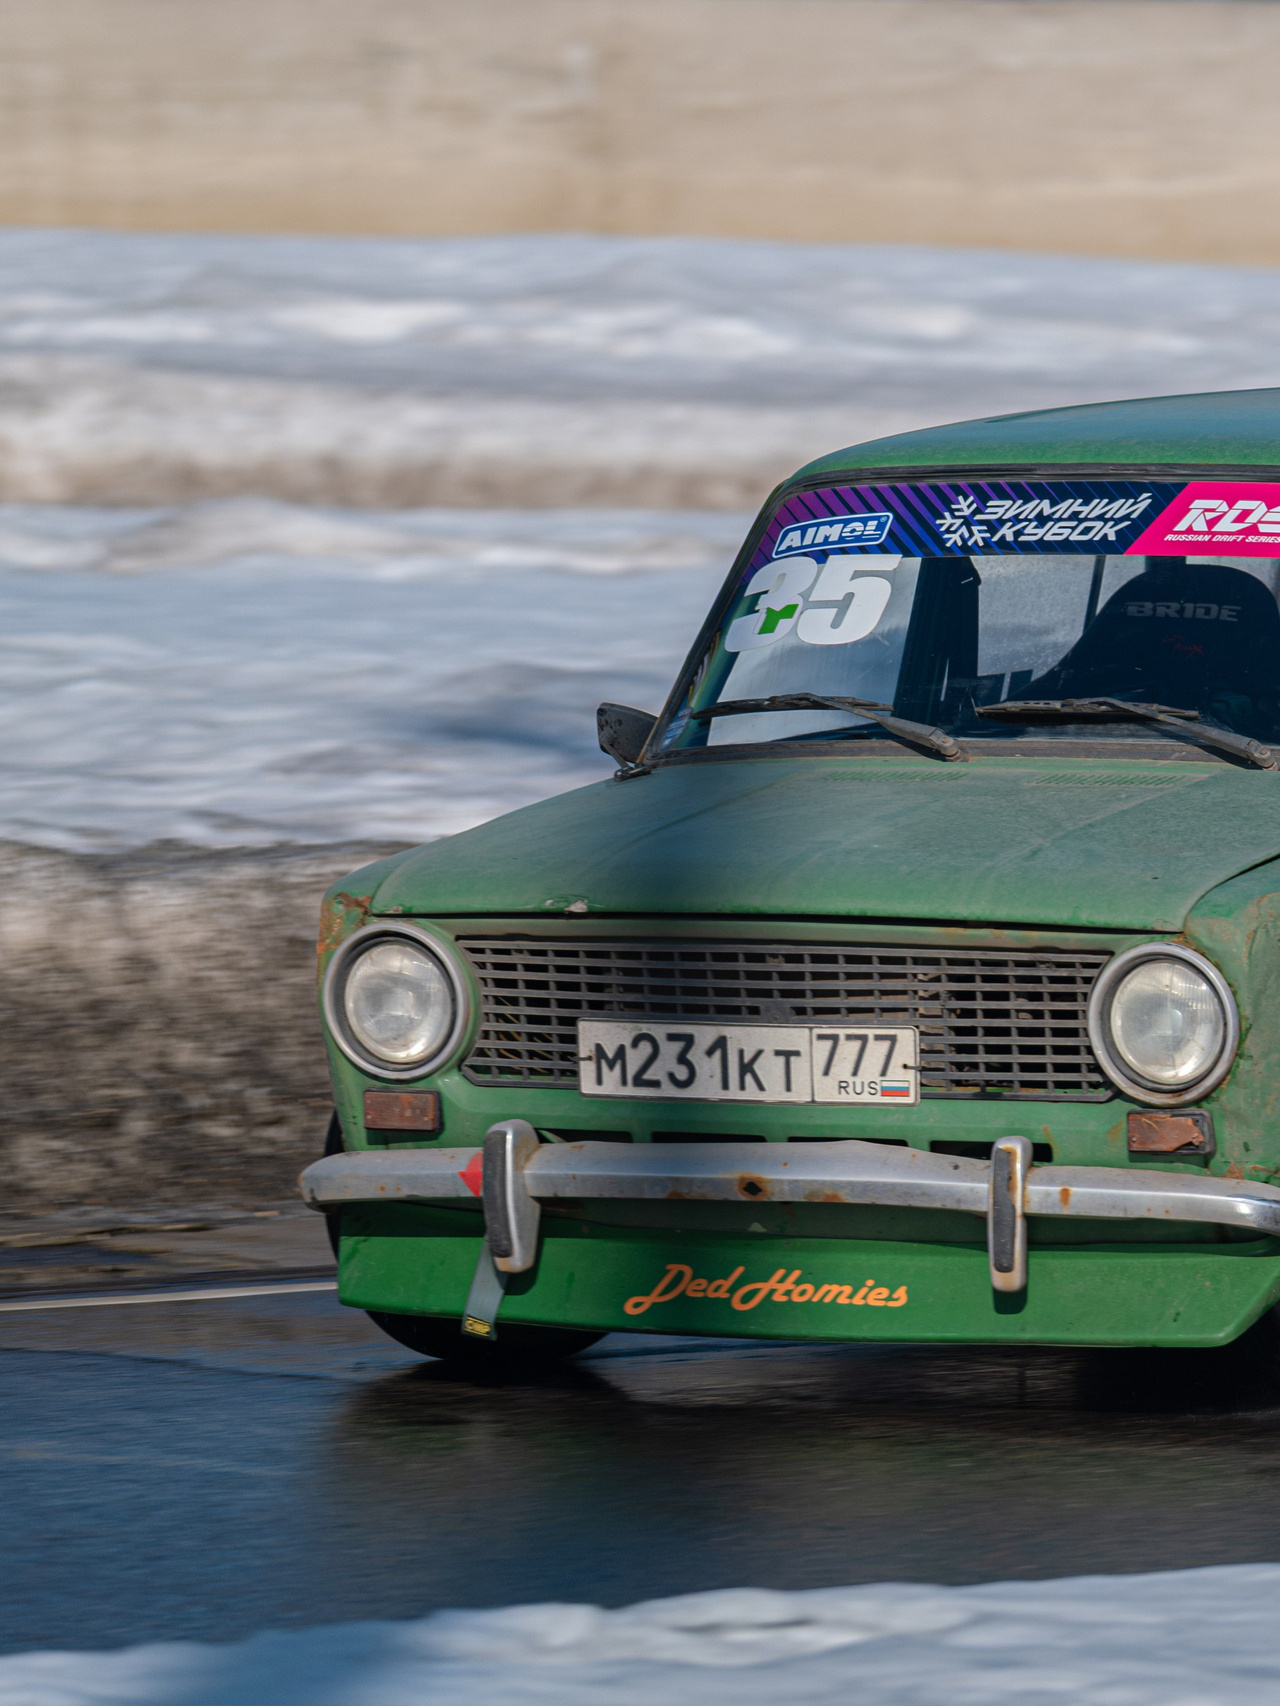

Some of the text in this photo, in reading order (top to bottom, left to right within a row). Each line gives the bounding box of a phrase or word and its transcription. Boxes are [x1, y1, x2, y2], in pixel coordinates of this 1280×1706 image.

[973, 493, 1153, 520] ЗИМНИЙ
[777, 520, 882, 551] AIMOL
[991, 520, 1131, 542] КУБОК
[1163, 534, 1212, 542] RUSSIAN
[1212, 534, 1246, 543] DRIFT
[724, 554, 903, 653] 35
[1125, 601, 1242, 622] BRIDE
[597, 1032, 899, 1094] М231КТ 777
[838, 1080, 879, 1096] RUS
[624, 1263, 909, 1315] Ded Homies
